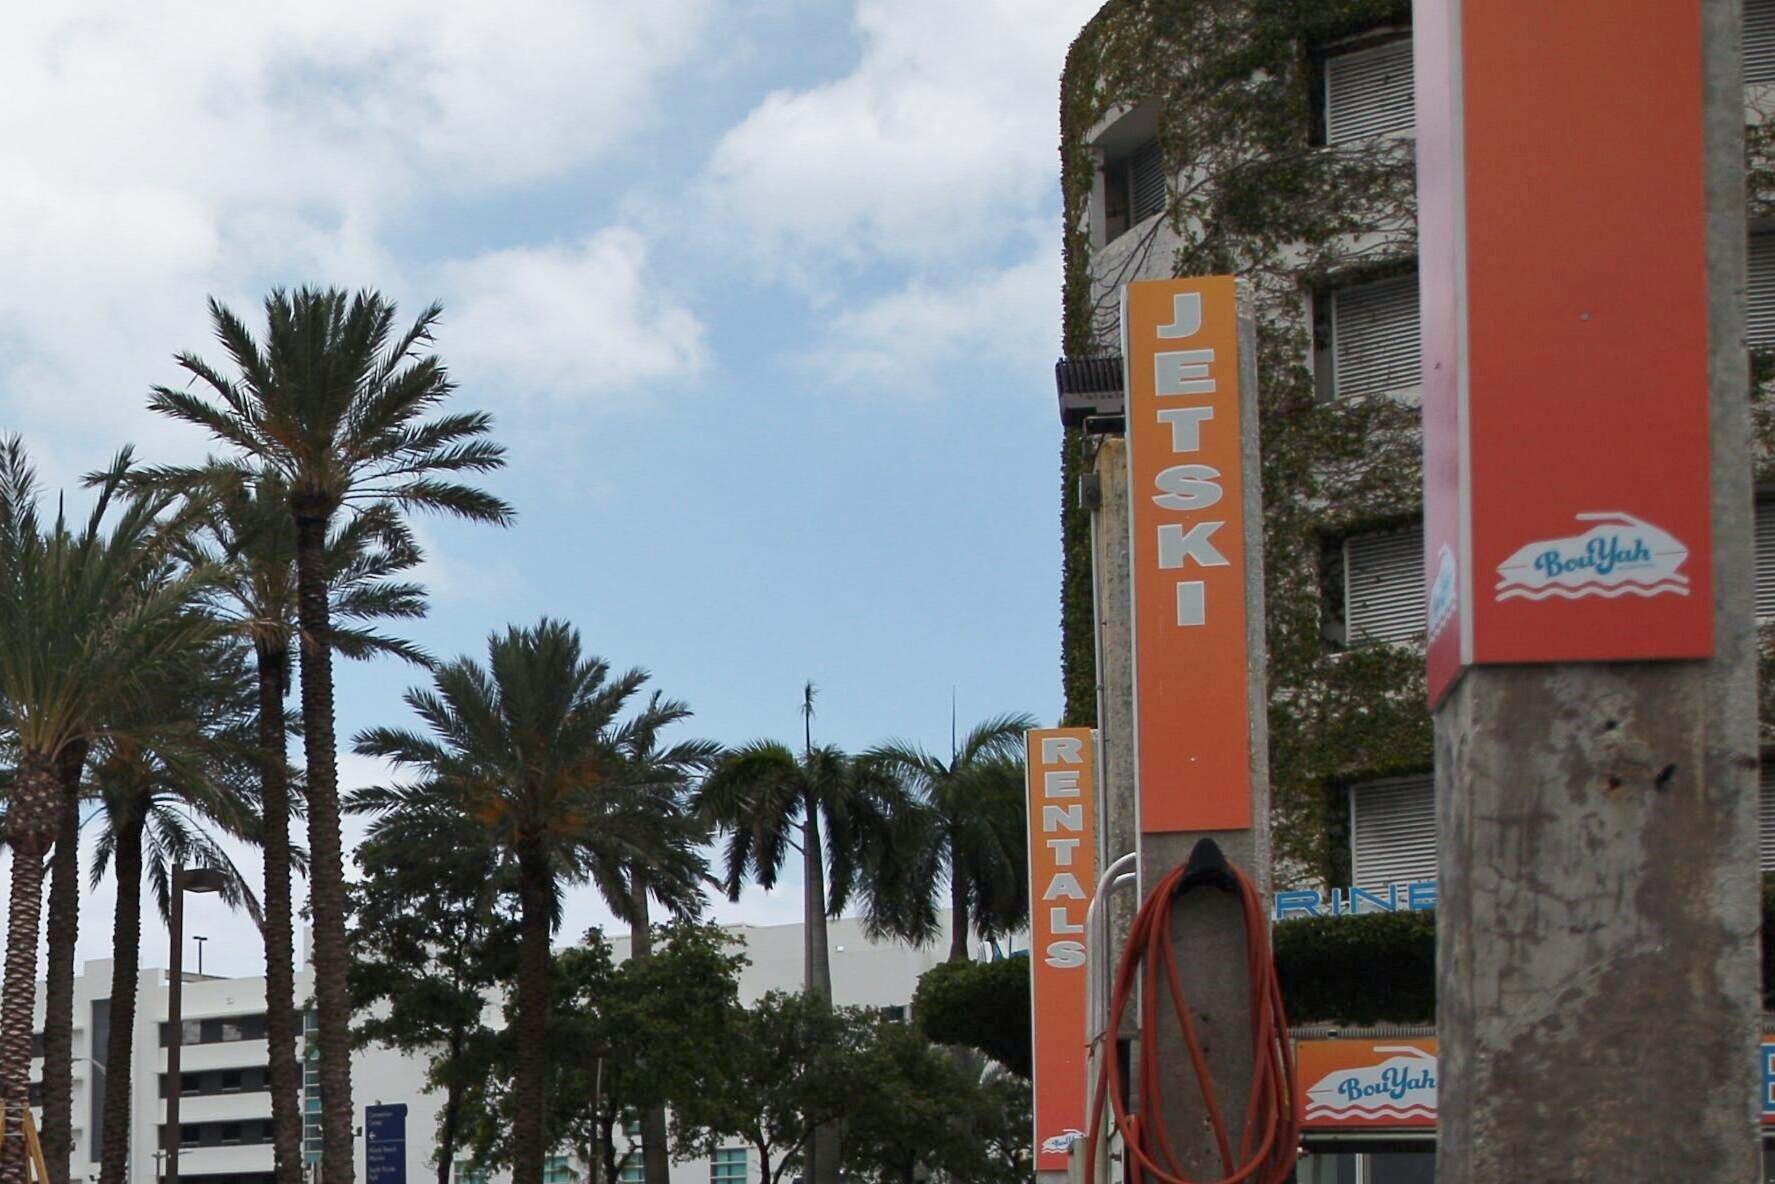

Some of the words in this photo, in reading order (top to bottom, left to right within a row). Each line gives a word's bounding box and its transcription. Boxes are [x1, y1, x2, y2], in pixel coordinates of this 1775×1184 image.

[1534, 535, 1652, 579] BouYah
[1041, 736, 1088, 969] RENTALS
[1337, 1066, 1436, 1102] BouYah
